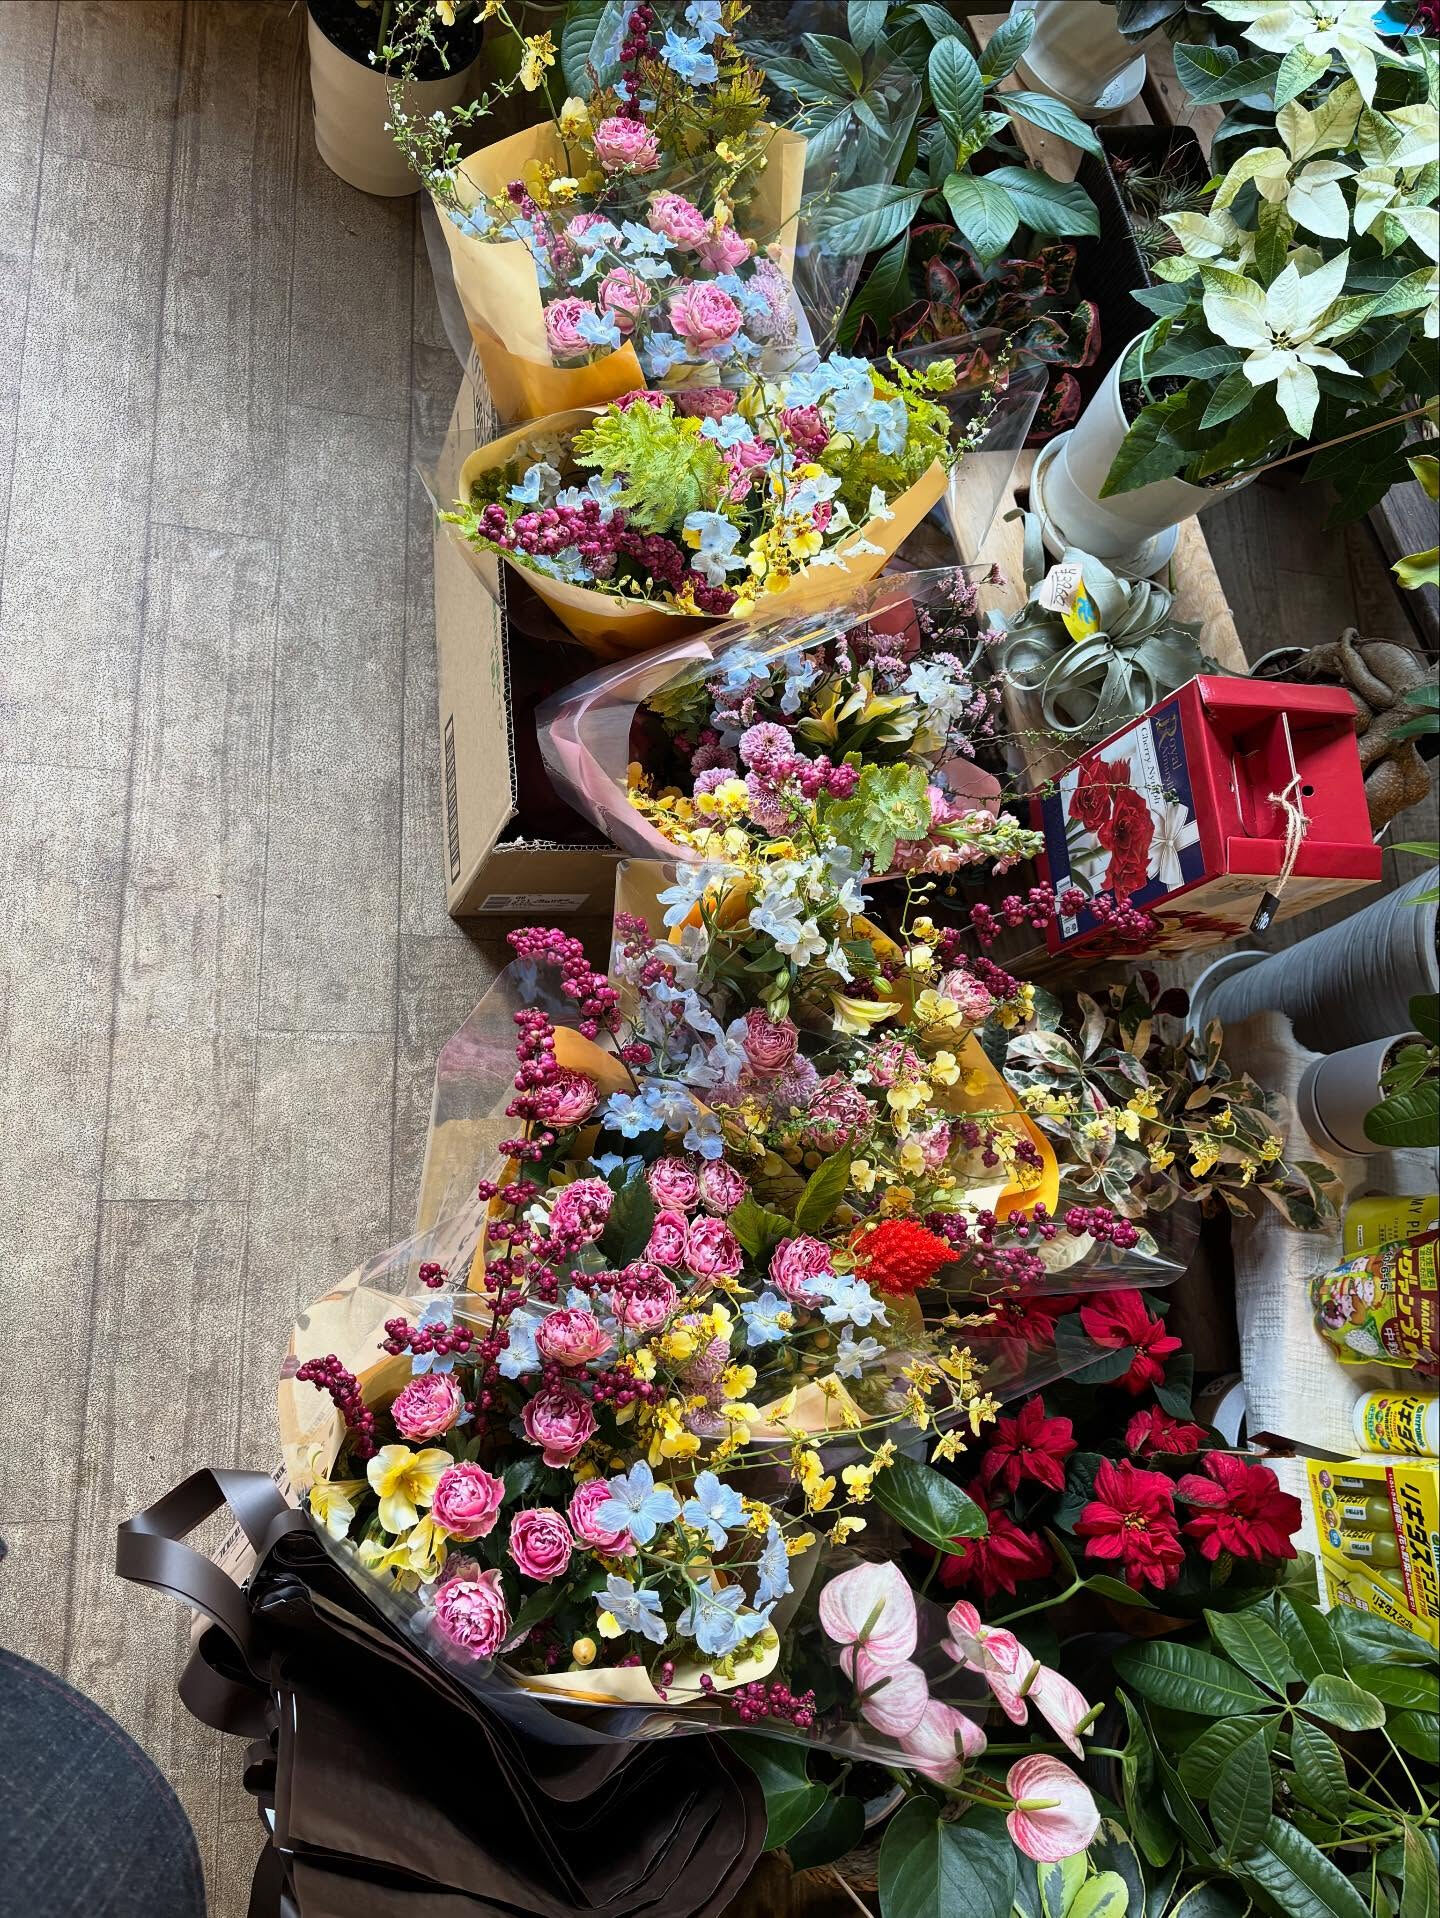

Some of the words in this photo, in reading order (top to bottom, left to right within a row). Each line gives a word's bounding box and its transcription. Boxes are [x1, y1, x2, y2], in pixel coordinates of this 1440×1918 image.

[1141, 727, 1152, 762] Cherry
[1156, 713, 1183, 770] Royal
[1410, 1199, 1426, 1214] MY
[1406, 1221, 1420, 1237] PL
[1396, 1396, 1423, 1456] リキダス
